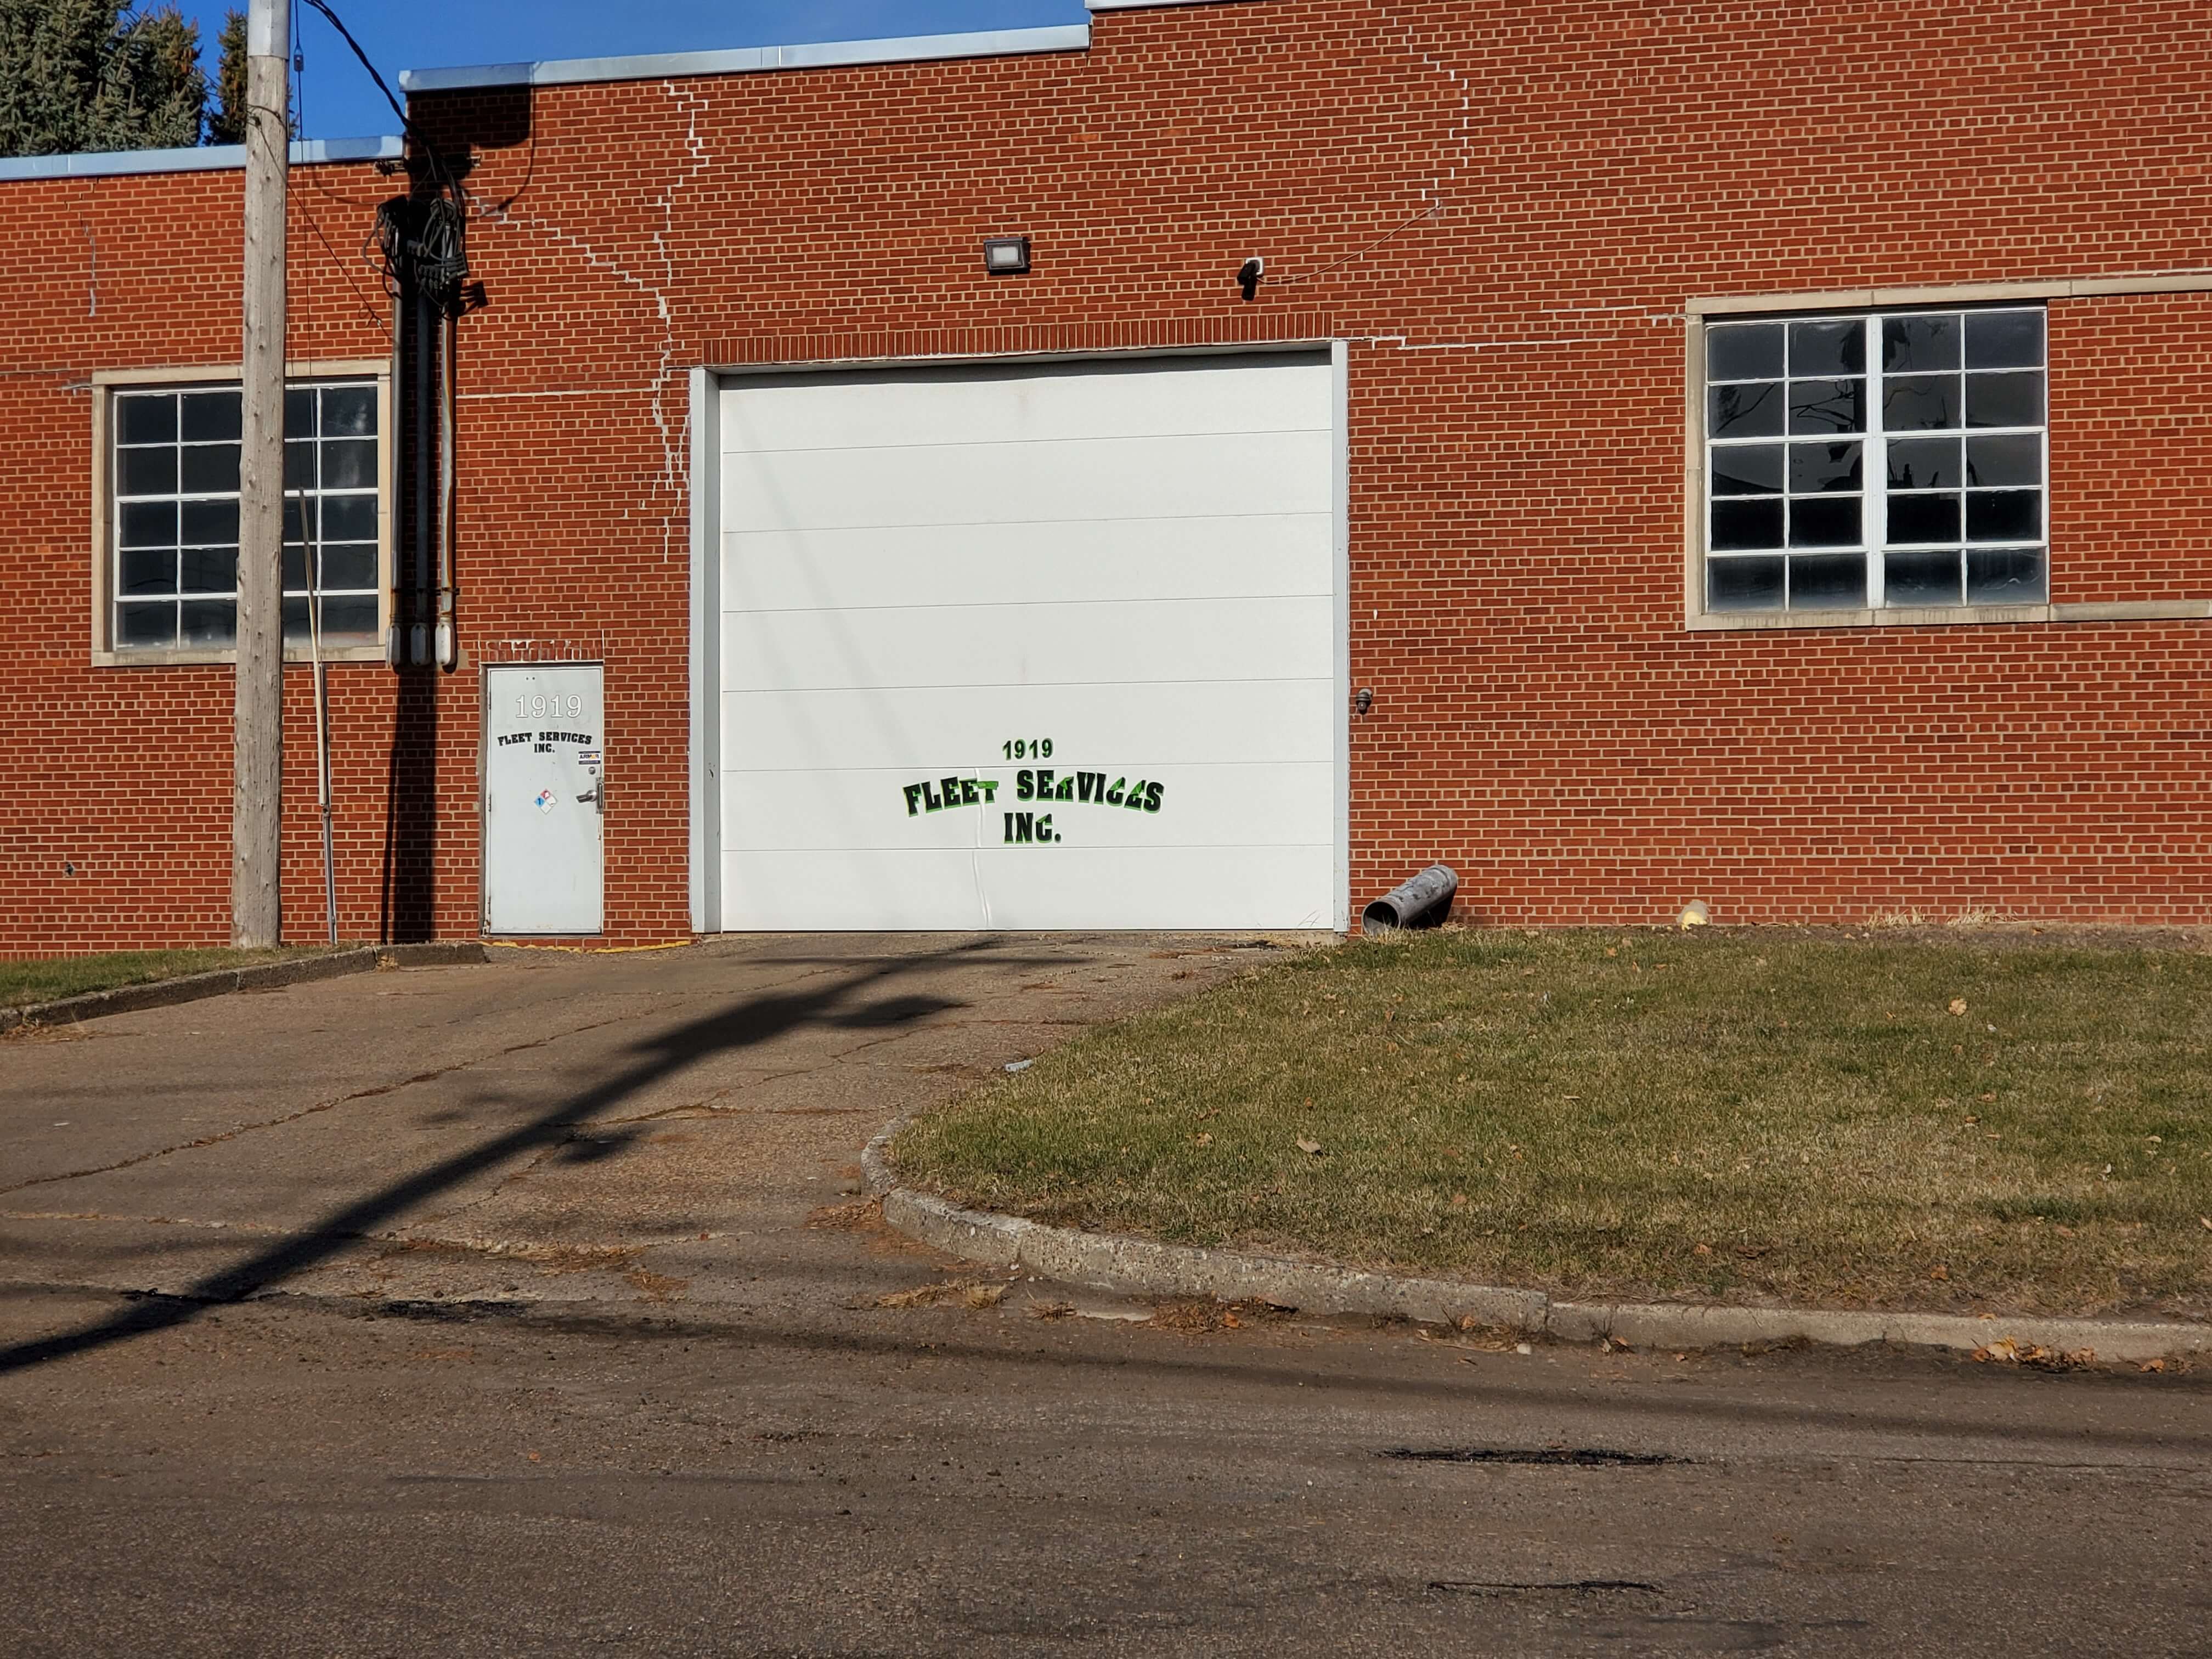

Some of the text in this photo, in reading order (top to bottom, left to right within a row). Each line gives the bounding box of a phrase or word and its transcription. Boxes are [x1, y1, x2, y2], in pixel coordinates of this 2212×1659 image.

[516, 695, 582, 718] 1919
[498, 731, 592, 746] FLEET SERVICES
[534, 743, 556, 753] INC.
[1002, 738, 1053, 761] 1919
[902, 776, 998, 818] FLEET
[1003, 812, 1063, 845] INC.
